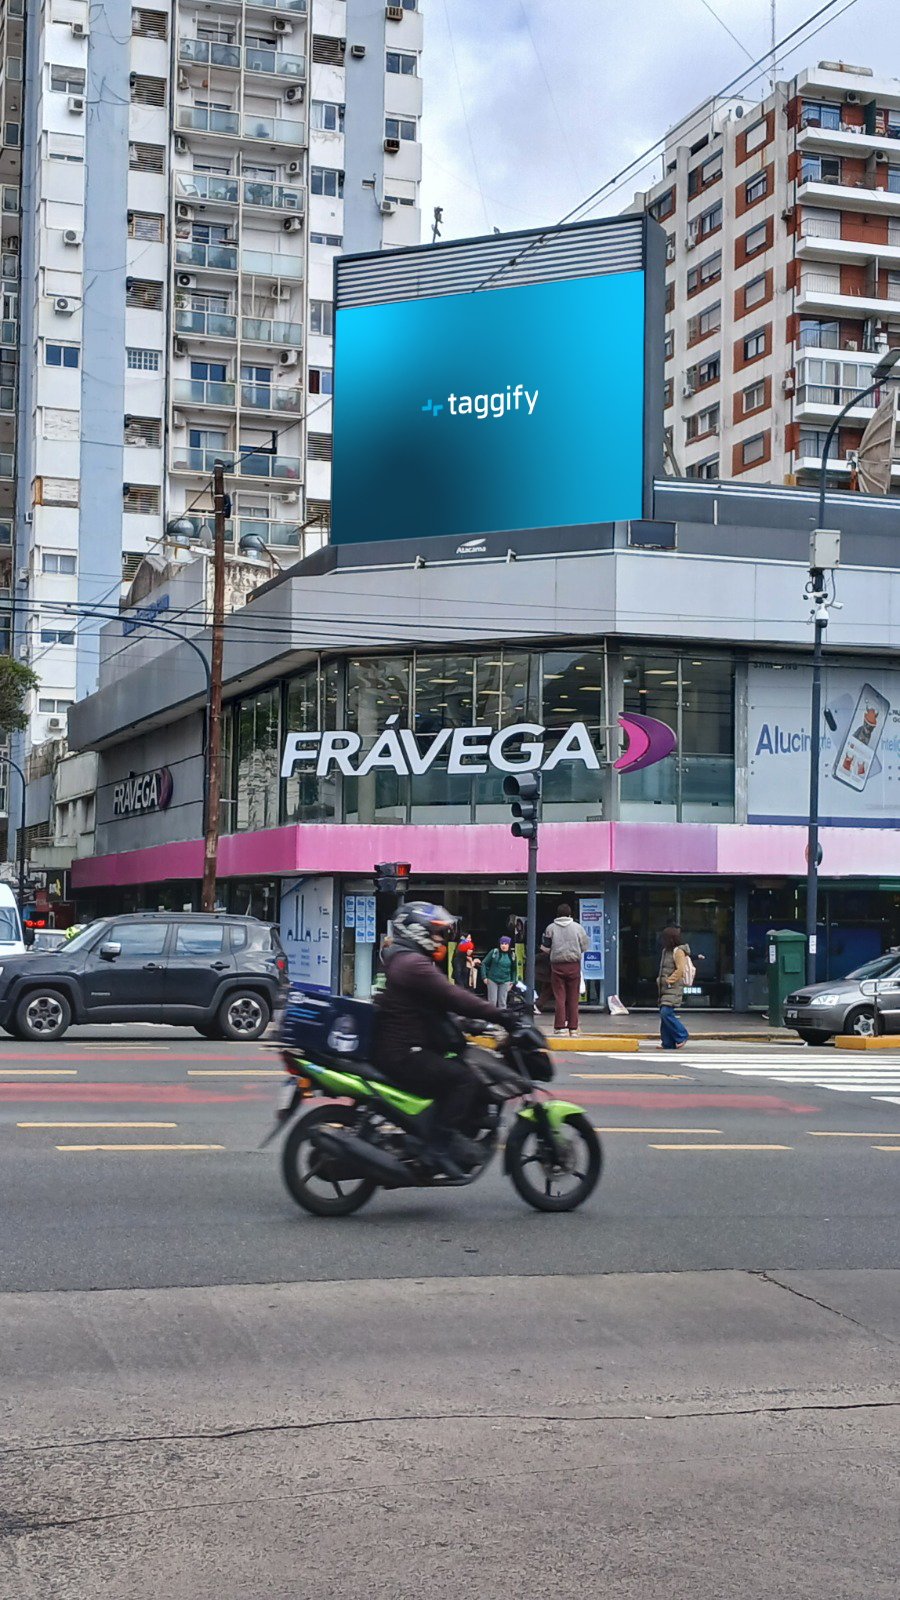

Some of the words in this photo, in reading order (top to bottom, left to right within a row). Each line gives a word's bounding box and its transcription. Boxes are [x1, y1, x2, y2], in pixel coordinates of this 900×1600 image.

[447, 384, 539, 419] taggify
[456, 546, 487, 554] Atacama
[281, 714, 600, 778] FRÁVEGA
[683, 986, 702, 994] SUNG
